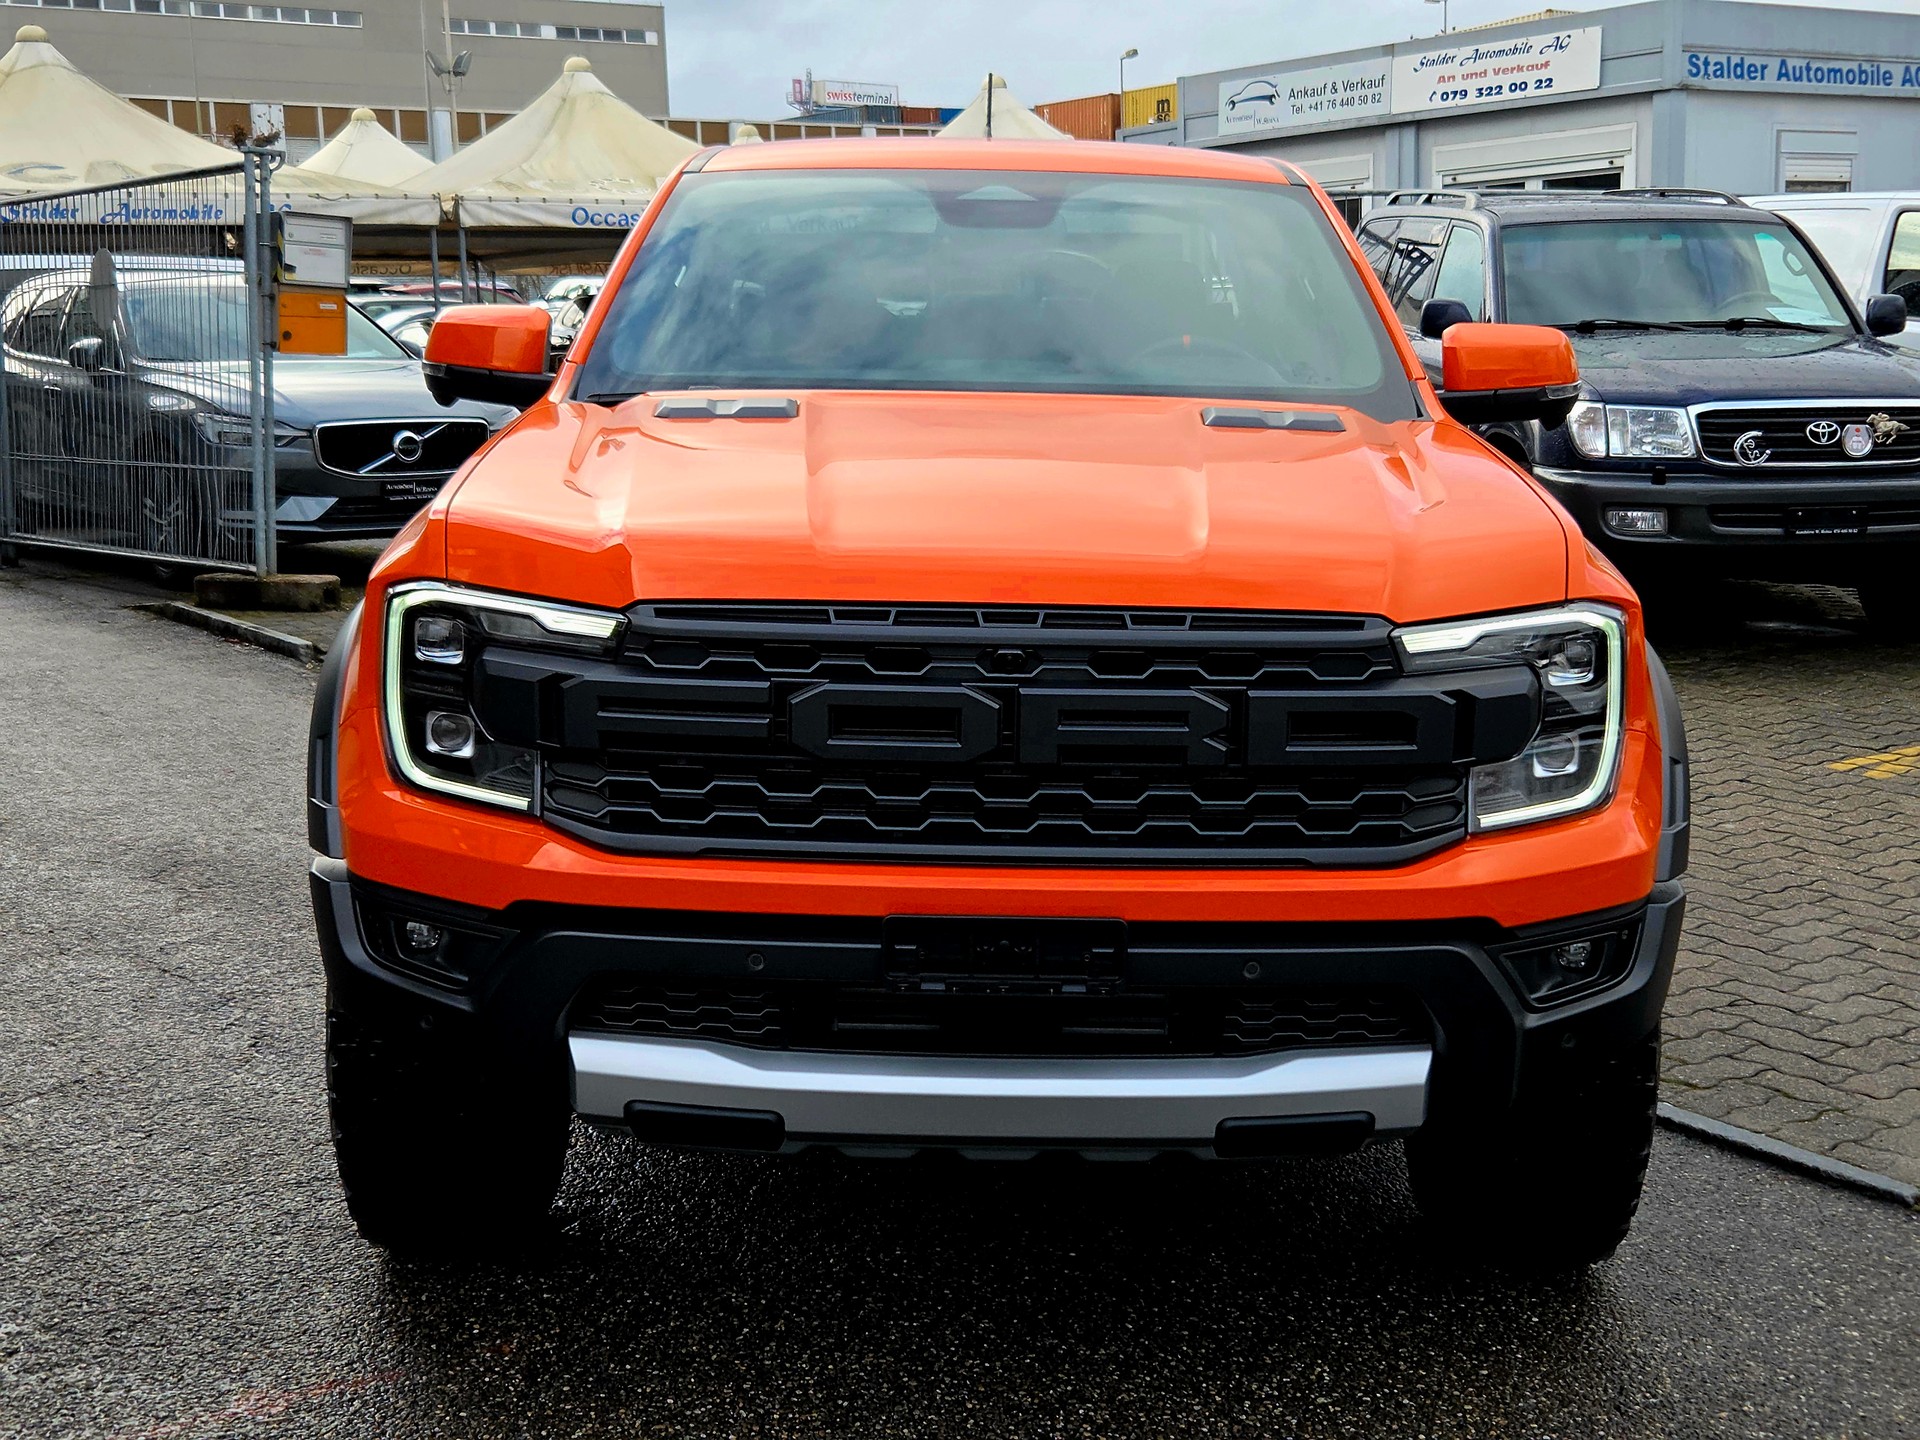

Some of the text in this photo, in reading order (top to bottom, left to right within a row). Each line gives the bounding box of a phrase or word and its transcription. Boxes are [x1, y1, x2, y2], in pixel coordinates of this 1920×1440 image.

[1413, 34, 1572, 73] Stalder Automobile AG
[1436, 60, 1551, 84] An und Verkauf
[1687, 53, 1769, 81] Stalder
[1776, 58, 1893, 87] Automobile
[1288, 74, 1386, 101] Ankauf & Verkauf
[1440, 77, 1554, 102] 079 322 00 22
[1291, 93, 1382, 115] Tel. +41 76 440 50 82
[100, 203, 223, 224] Automobile
[571, 206, 643, 227] Occas
[560, 679, 1458, 767] FORD
